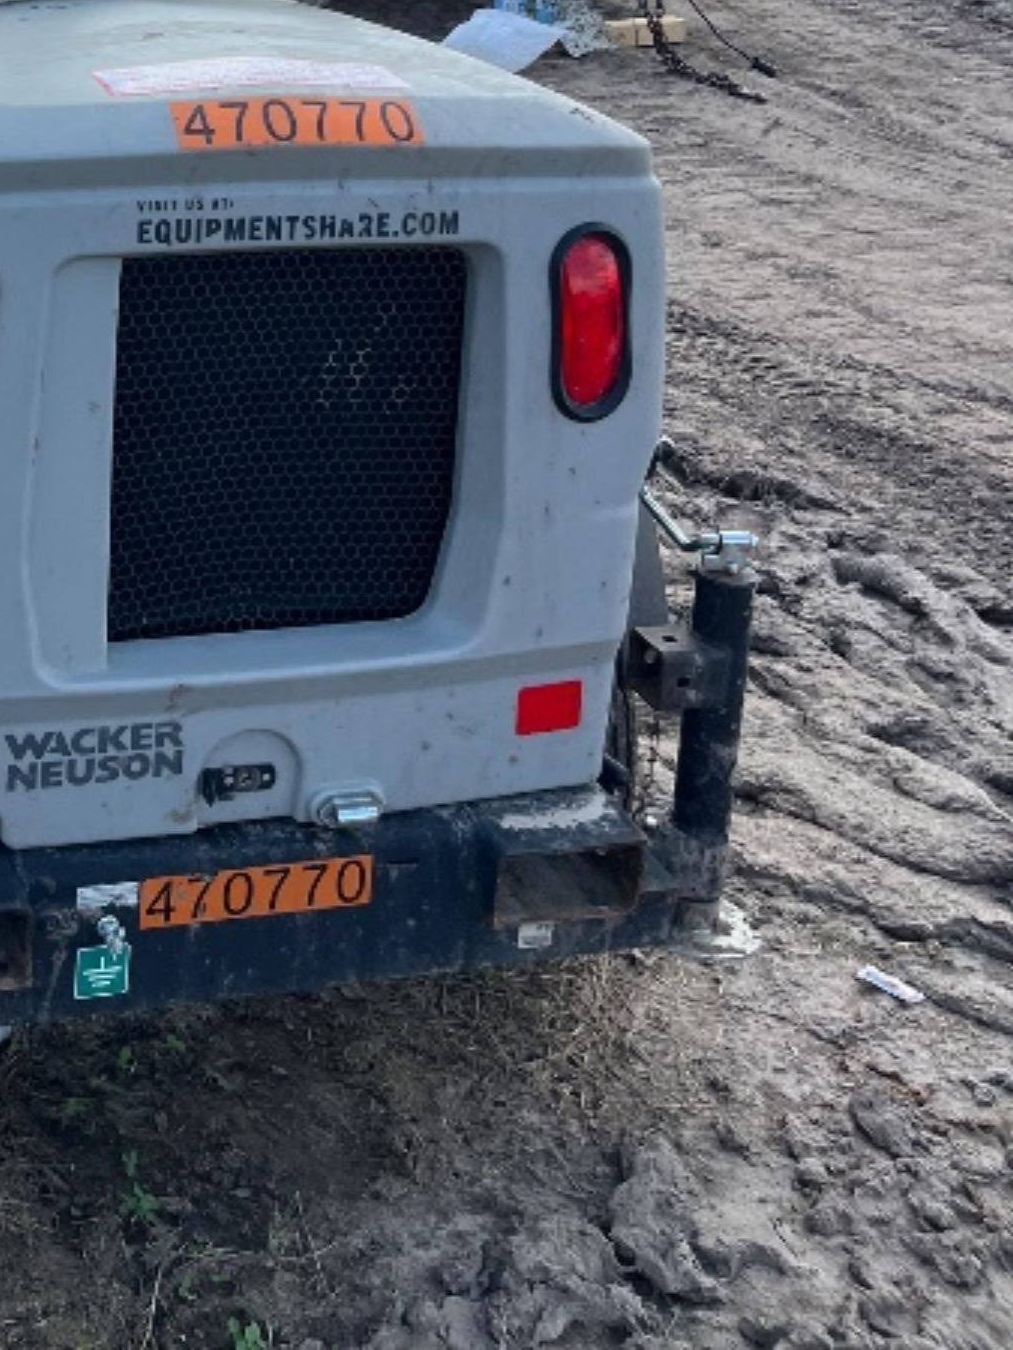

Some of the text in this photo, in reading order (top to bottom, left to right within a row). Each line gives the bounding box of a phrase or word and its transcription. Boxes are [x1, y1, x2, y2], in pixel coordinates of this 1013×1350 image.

[183, 99, 415, 145] 470770
[136, 199, 178, 212] VISIT
[185, 198, 204, 211] US
[136, 210, 460, 246] EQUIPMENTSHARE.COM
[4, 721, 184, 760] WACKER
[5, 749, 184, 792] NEUSON
[144, 859, 368, 924] 470770
